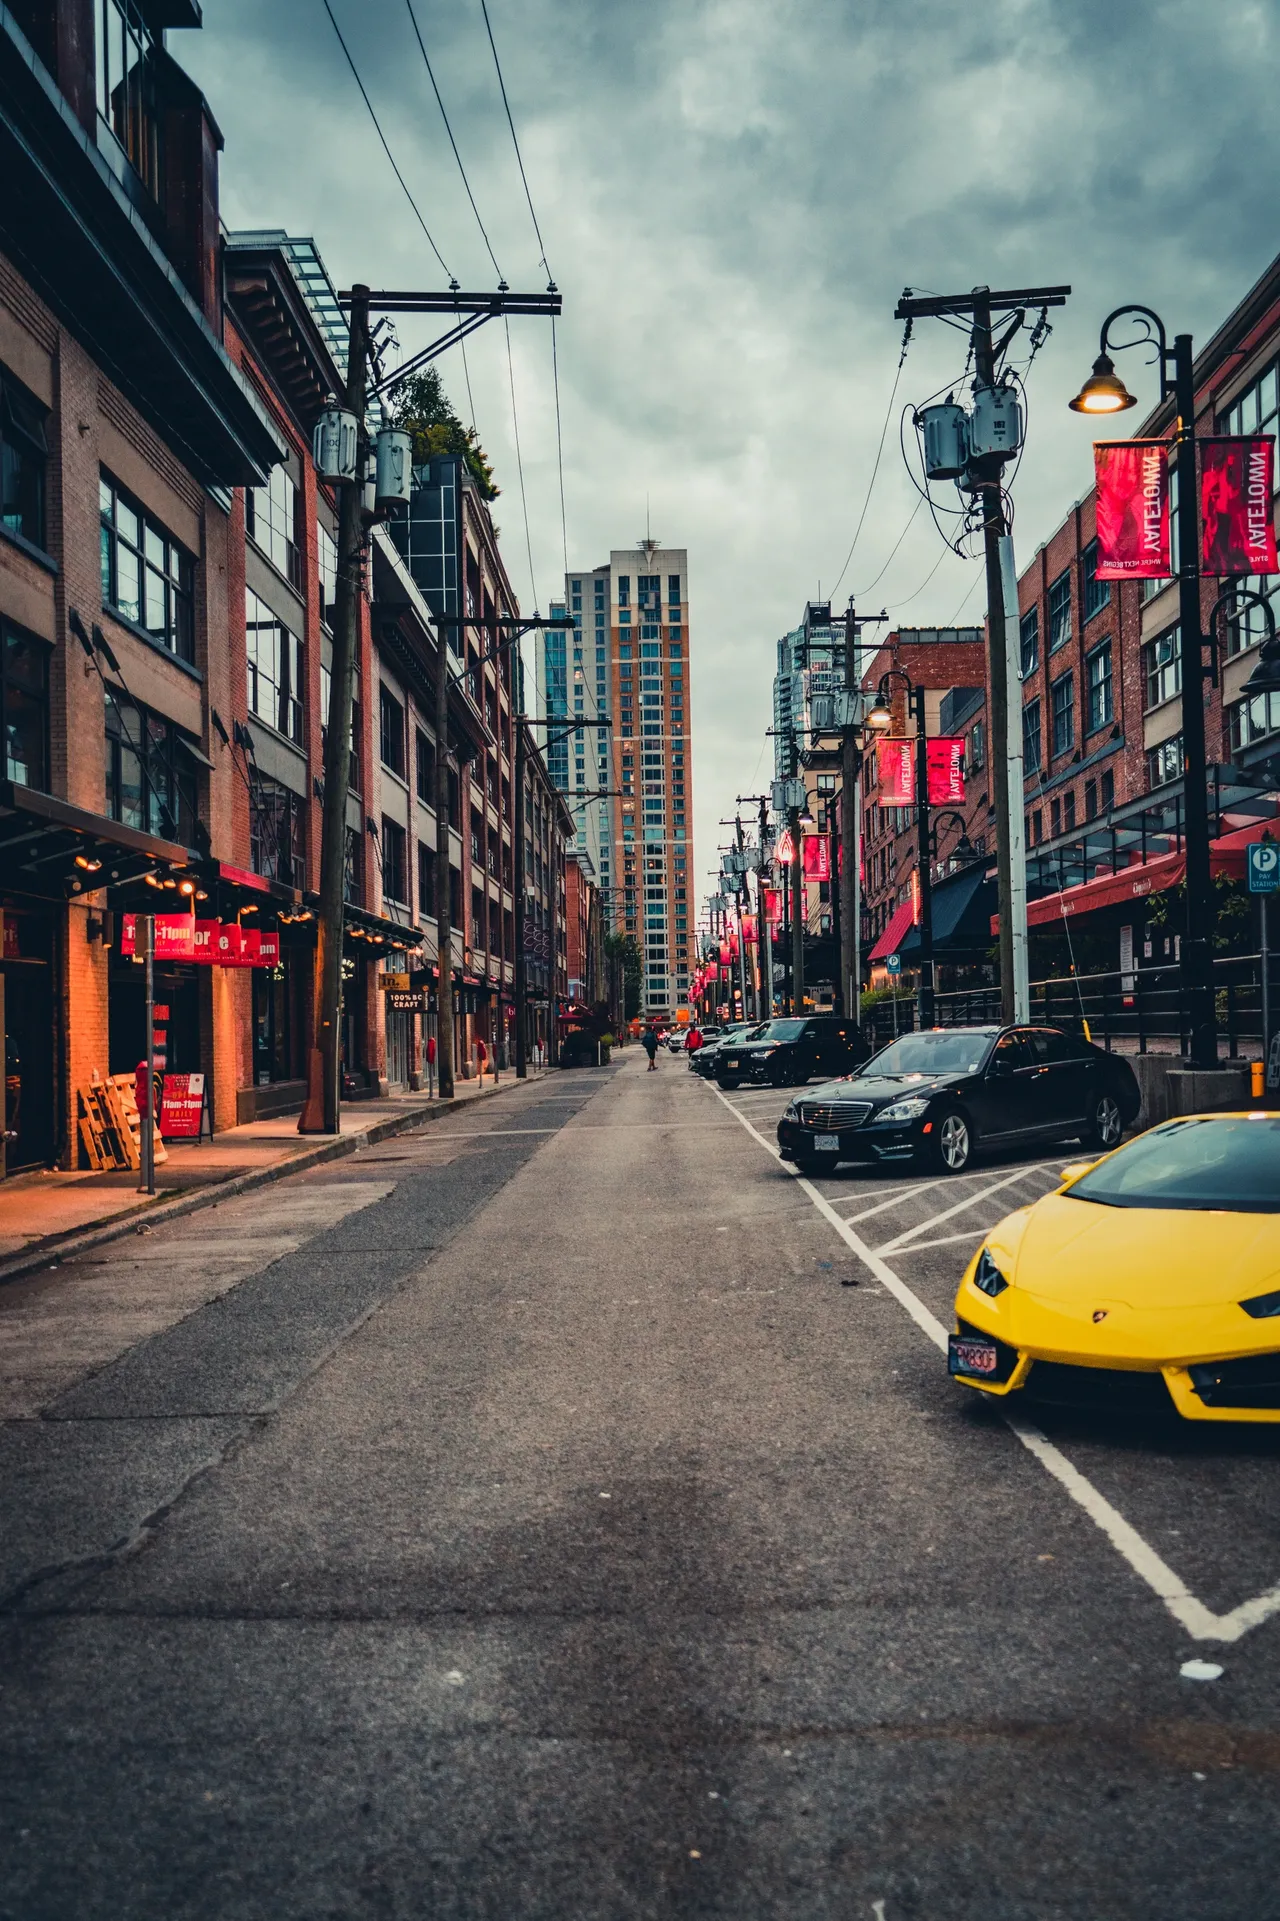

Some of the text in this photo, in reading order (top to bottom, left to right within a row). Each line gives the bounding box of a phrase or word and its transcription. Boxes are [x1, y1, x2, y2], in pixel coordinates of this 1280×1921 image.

[1252, 880, 1279, 888] STATION
[163, 1100, 202, 1109] 11am-11pm
[169, 1110, 194, 1118] DAILY
